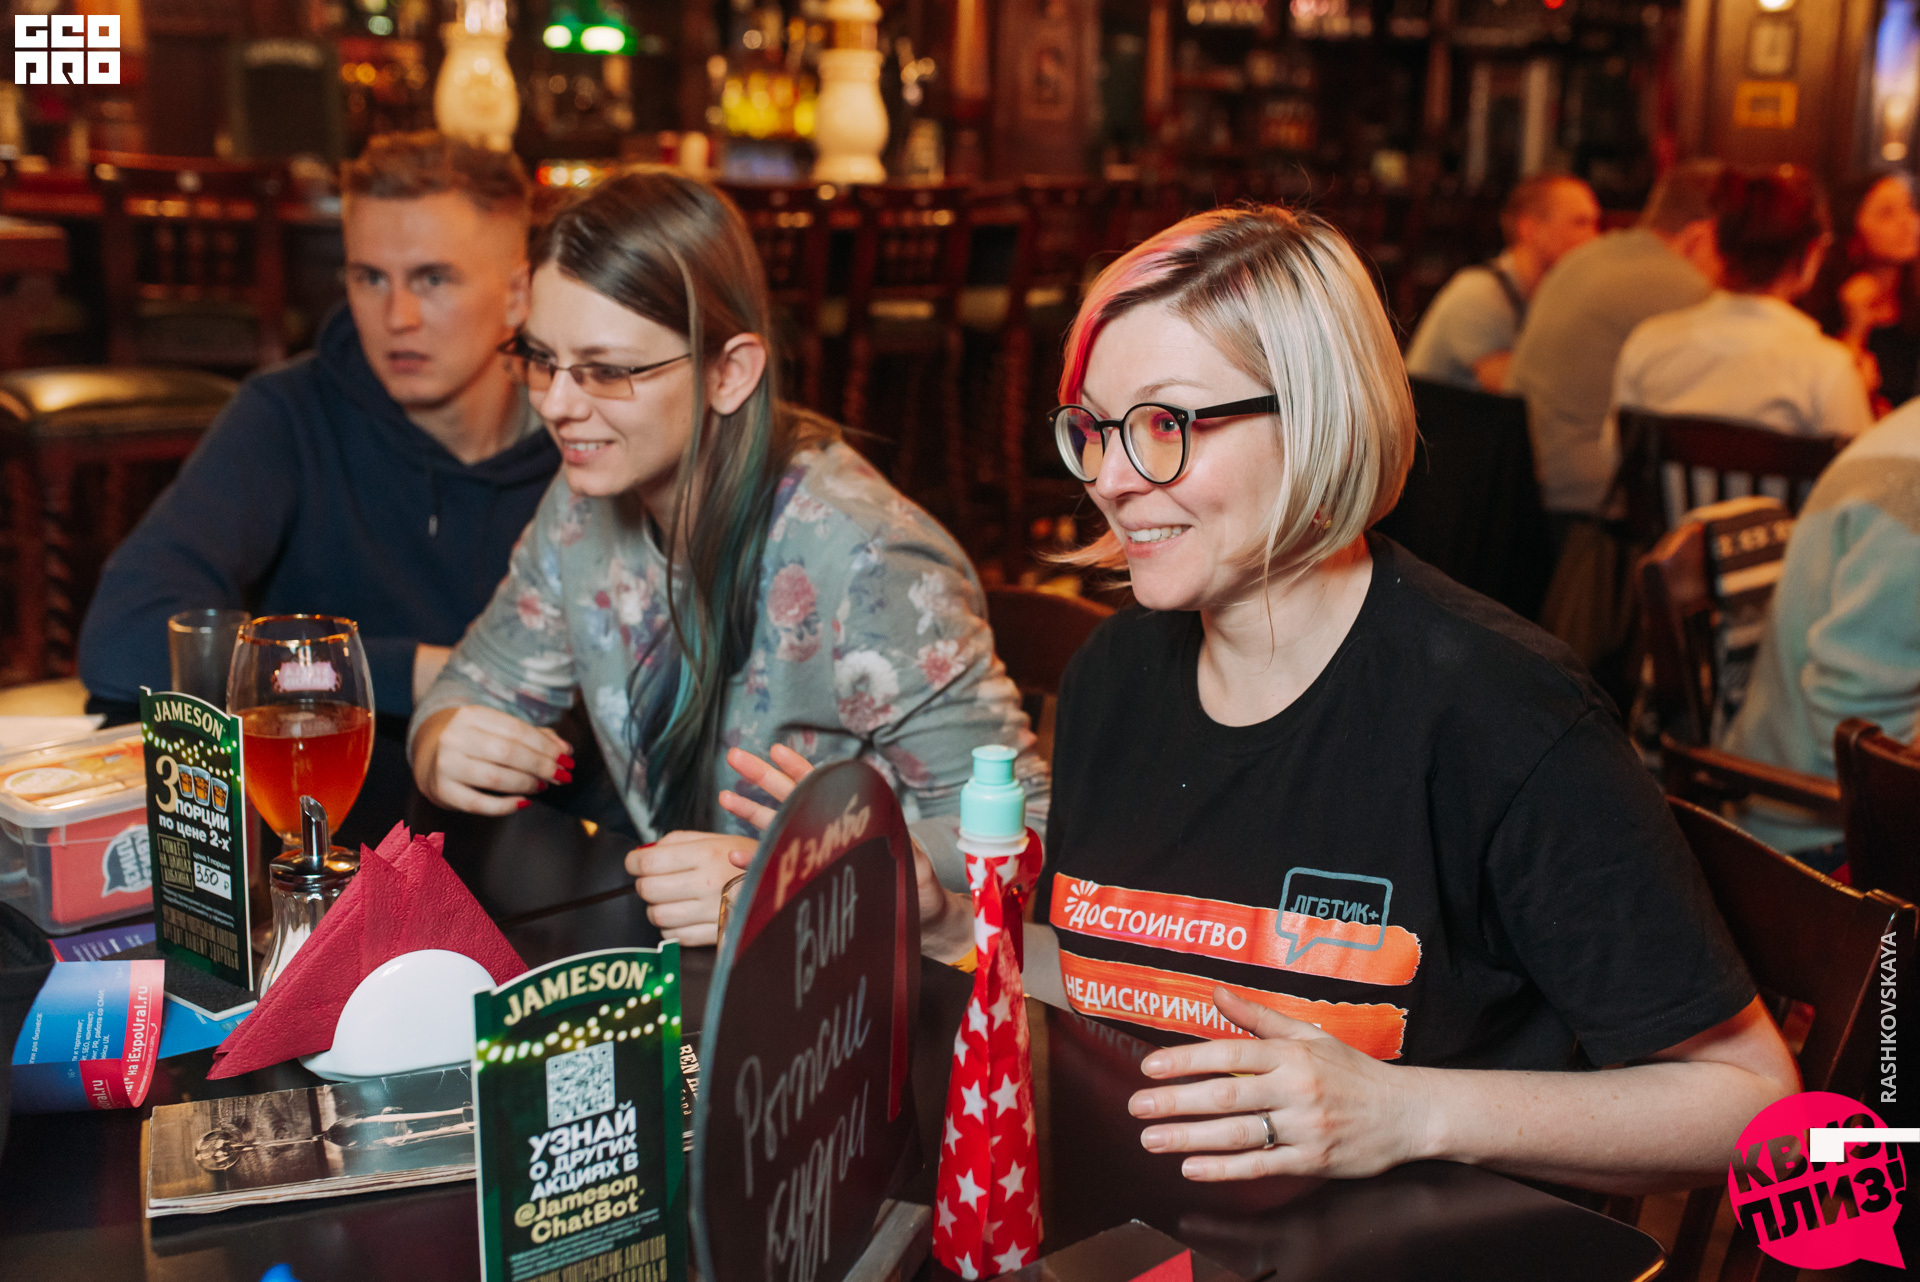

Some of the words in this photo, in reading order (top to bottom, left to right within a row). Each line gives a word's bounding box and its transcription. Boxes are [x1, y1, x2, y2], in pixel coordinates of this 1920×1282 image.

[154, 700, 223, 741] JAMESON
[156, 755, 179, 813] 3
[158, 814, 174, 830] по
[177, 821, 207, 843] цене
[175, 799, 230, 832] ПОРЦИИ
[196, 865, 219, 886] 350
[1068, 900, 1247, 950] ДОСТОИНСТВО
[1290, 894, 1380, 925] ЛГБТИК+
[503, 959, 648, 1026] JAMESON
[127, 985, 148, 1062] iExpoUral.ru
[528, 1100, 637, 1163] УЗНАЙ
[529, 1160, 549, 1181] О
[551, 1132, 638, 1179] ДРУГИХ
[514, 1174, 639, 1227] @Jameson
[530, 1156, 620, 1202] АКЦИЯХ
[623, 1151, 639, 1172] В
